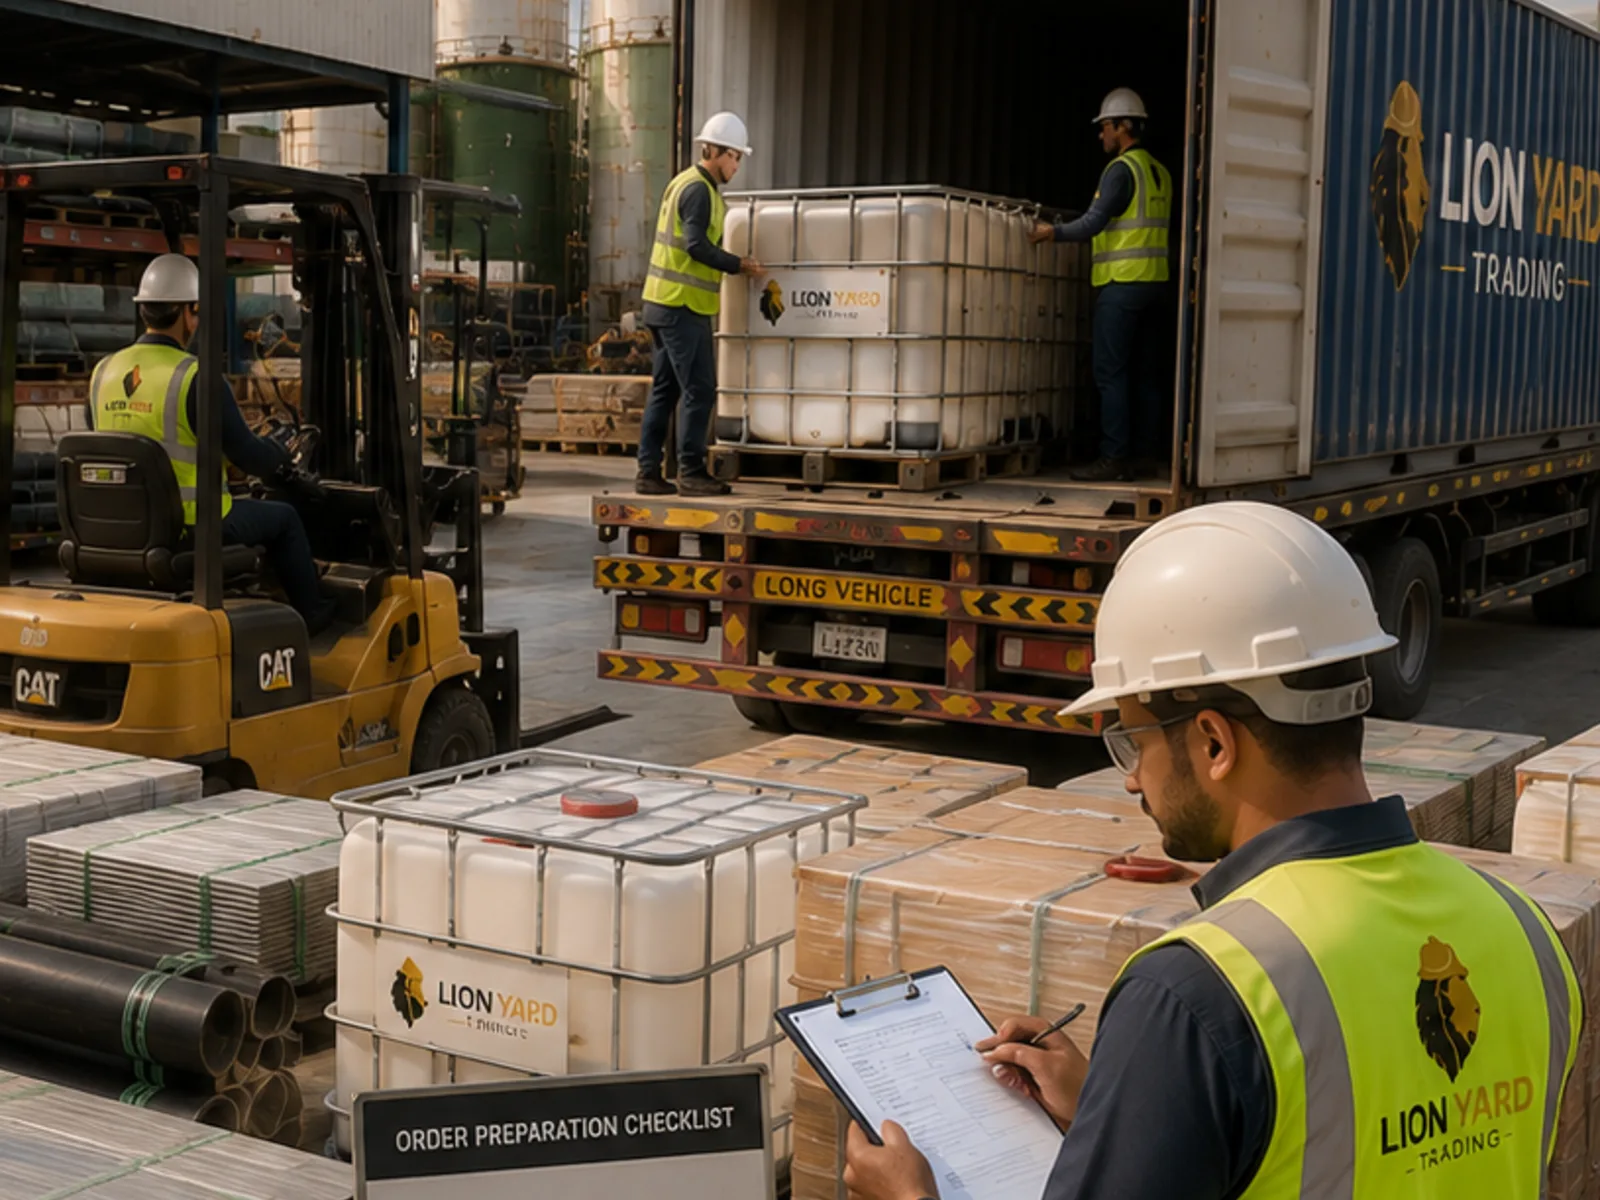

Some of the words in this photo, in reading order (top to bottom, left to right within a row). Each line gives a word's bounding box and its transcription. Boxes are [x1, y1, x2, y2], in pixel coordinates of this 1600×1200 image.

[1440, 132, 1525, 231] LION
[1533, 153, 1600, 244] YARD
[1472, 252, 1565, 301] TRADING
[765, 576, 826, 599] LONG
[835, 579, 932, 608] VEHICLE
[16, 667, 60, 707] CAT
[259, 648, 295, 691] CAT
[438, 981, 493, 1014] LION
[497, 991, 558, 1027] YARD
[396, 1126, 469, 1152] ORDER
[476, 1115, 618, 1147] PREPARATION
[624, 1106, 735, 1136] CHECKLIST
[1381, 1096, 1447, 1155] LION
[1453, 1075, 1534, 1127] YARD
[1418, 1129, 1500, 1170] TRADING
